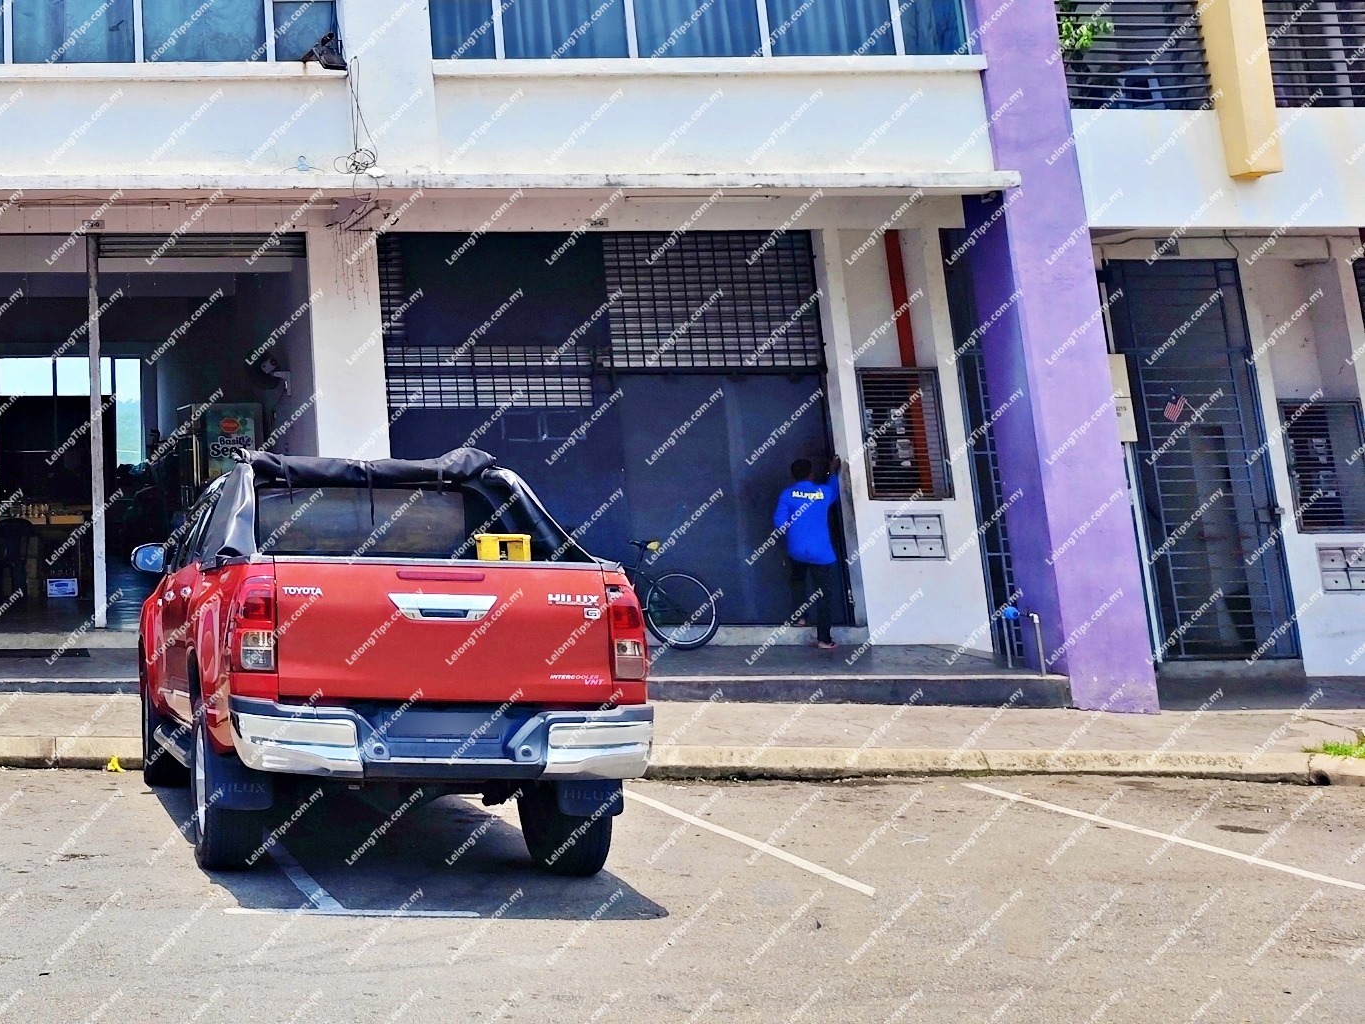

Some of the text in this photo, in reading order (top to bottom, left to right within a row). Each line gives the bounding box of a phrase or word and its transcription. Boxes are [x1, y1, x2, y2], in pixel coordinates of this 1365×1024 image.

[282, 586, 324, 596] TOYOTA
[547, 593, 600, 606] HILUX
[584, 678, 604, 686] VNT
